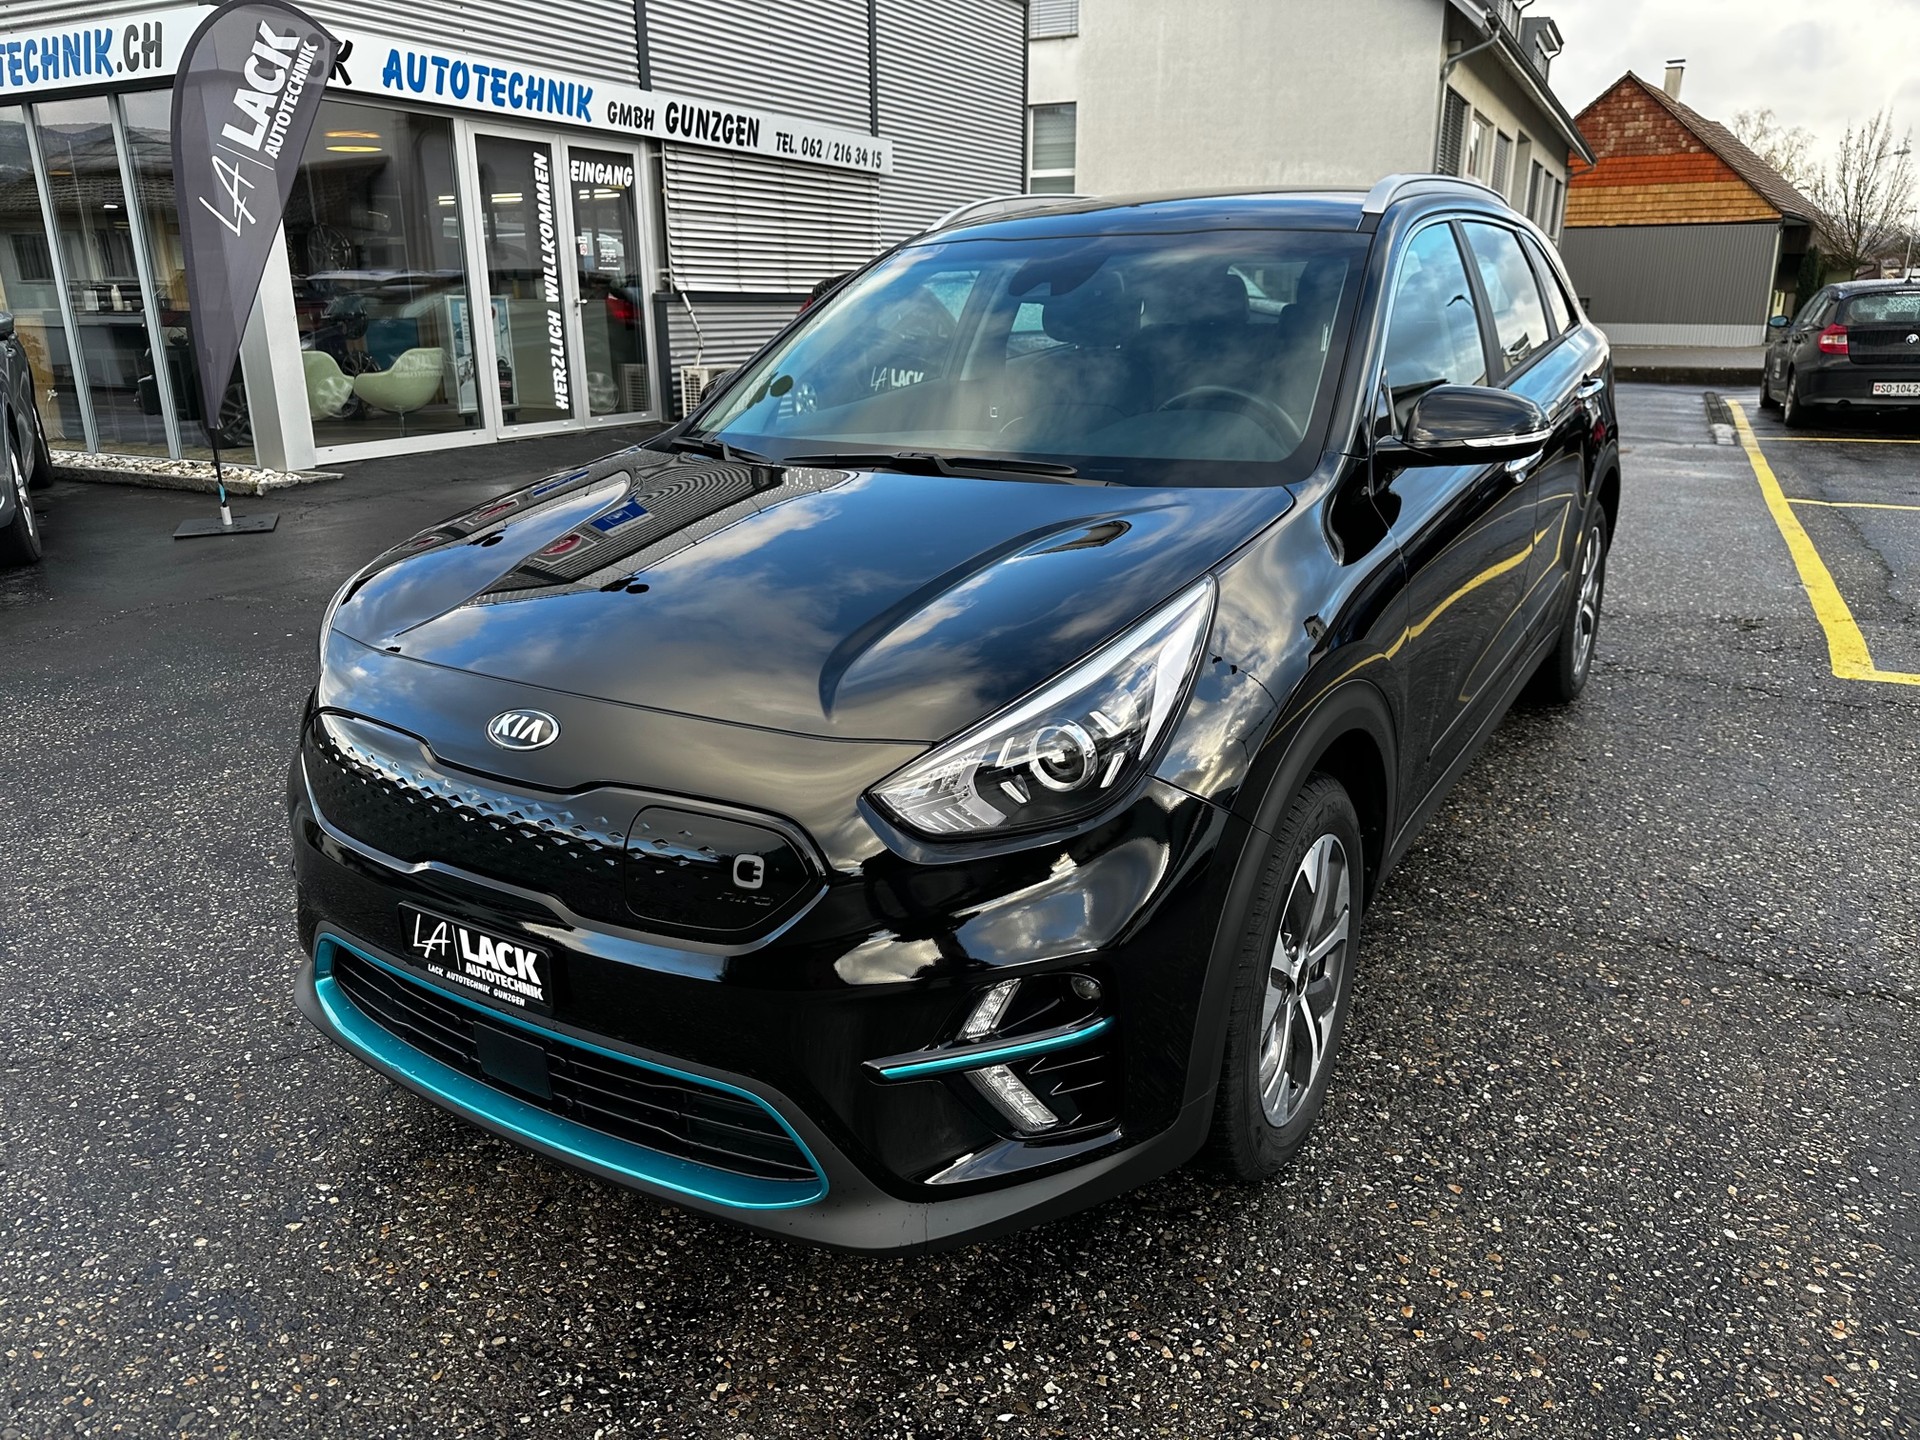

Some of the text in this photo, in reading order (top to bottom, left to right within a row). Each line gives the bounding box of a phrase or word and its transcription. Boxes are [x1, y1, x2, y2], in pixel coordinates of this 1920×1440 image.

[221, 20, 301, 152] LACK
[264, 40, 319, 159] AUTOTECHNIK
[383, 49, 593, 123] AUTOTECHNIK
[607, 101, 655, 131] GMBH
[665, 101, 760, 148] GUNZGEN
[776, 131, 797, 154] TEL.
[801, 136, 823, 158] 062
[833, 142, 852, 163] 216
[854, 146, 868, 167] 34
[871, 150, 882, 169] 15
[570, 160, 633, 187] EINGANG
[533, 152, 569, 410] HERZLICH WILLKOMMEN
[494, 713, 545, 743] KIA
[427, 963, 526, 1007] LACK AUTOTECHNIK GUNZGEN
[459, 928, 542, 985] LACK
[465, 962, 544, 1001] AUTOTECHNIK
